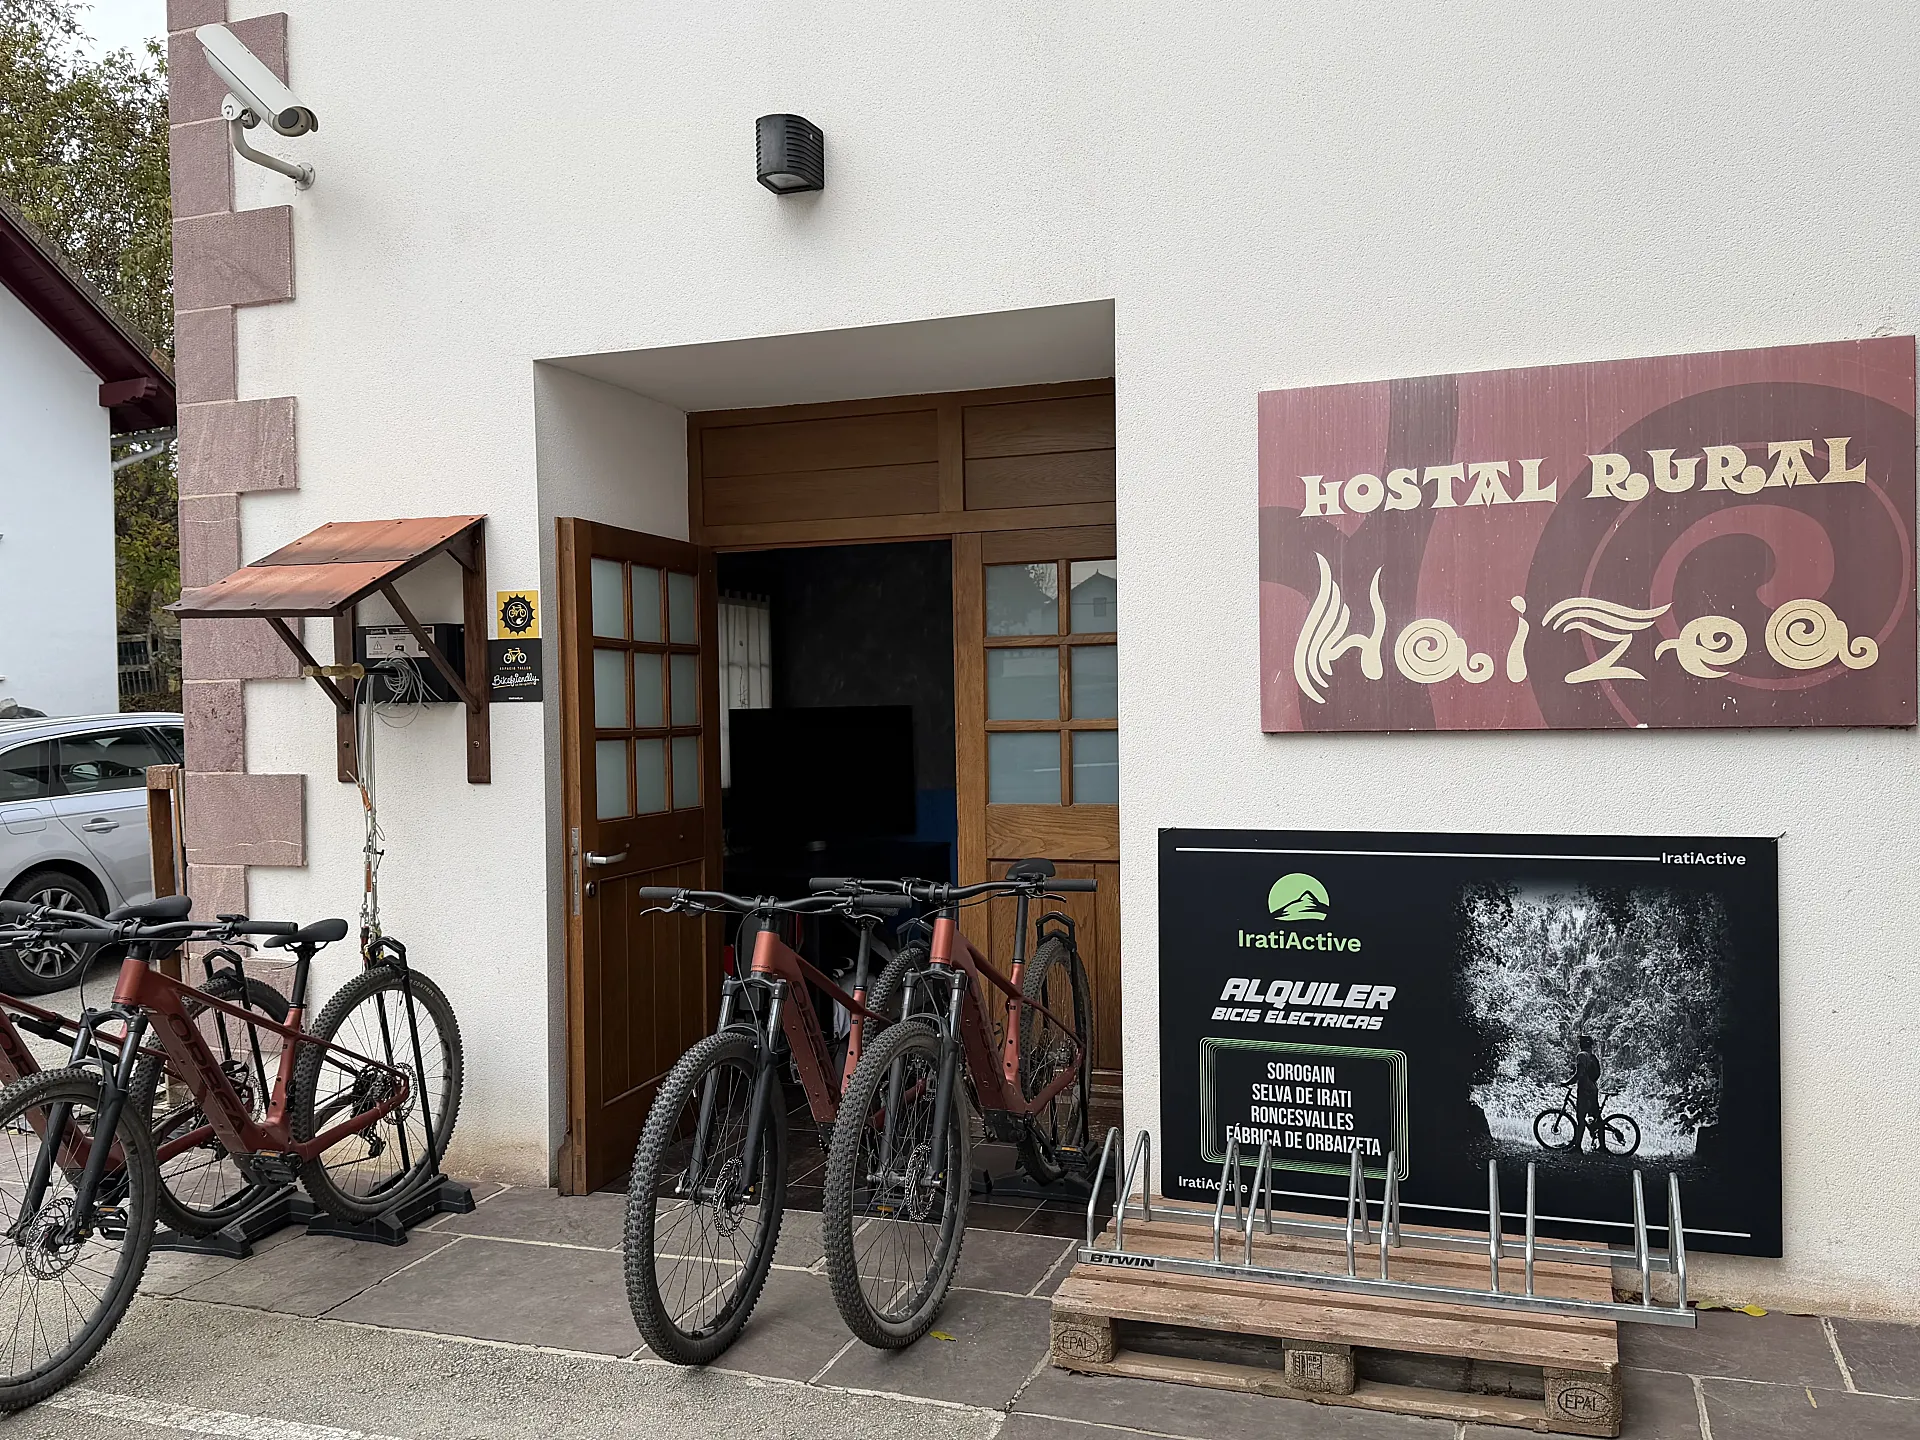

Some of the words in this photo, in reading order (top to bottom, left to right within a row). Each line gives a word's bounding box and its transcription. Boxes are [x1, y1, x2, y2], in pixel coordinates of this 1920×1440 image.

[1299, 456, 1558, 517] HOSTAL
[1585, 437, 1867, 502] RURAL
[1293, 551, 1879, 703] Haizea
[1662, 851, 1746, 865] IratiActive
[1238, 929, 1362, 952] IratiActive
[1220, 977, 1397, 1010] ALQUILER
[1211, 1007, 1262, 1022] BICIS
[1264, 1010, 1384, 1030] ELECTRICAS
[1267, 1062, 1335, 1084] SOROGAIN
[1252, 1083, 1293, 1103] SELVA
[1296, 1087, 1313, 1105] DE
[1317, 1089, 1352, 1107] IRATI
[1251, 1105, 1354, 1131] RONCESVALLES
[1285, 1130, 1303, 1149] DE
[1306, 1132, 1381, 1156] ORBAIZETA
[1090, 1253, 1155, 1267] B'TWIN
[1062, 1336, 1092, 1351] EPAL
[1565, 1393, 1600, 1412] EPAL
